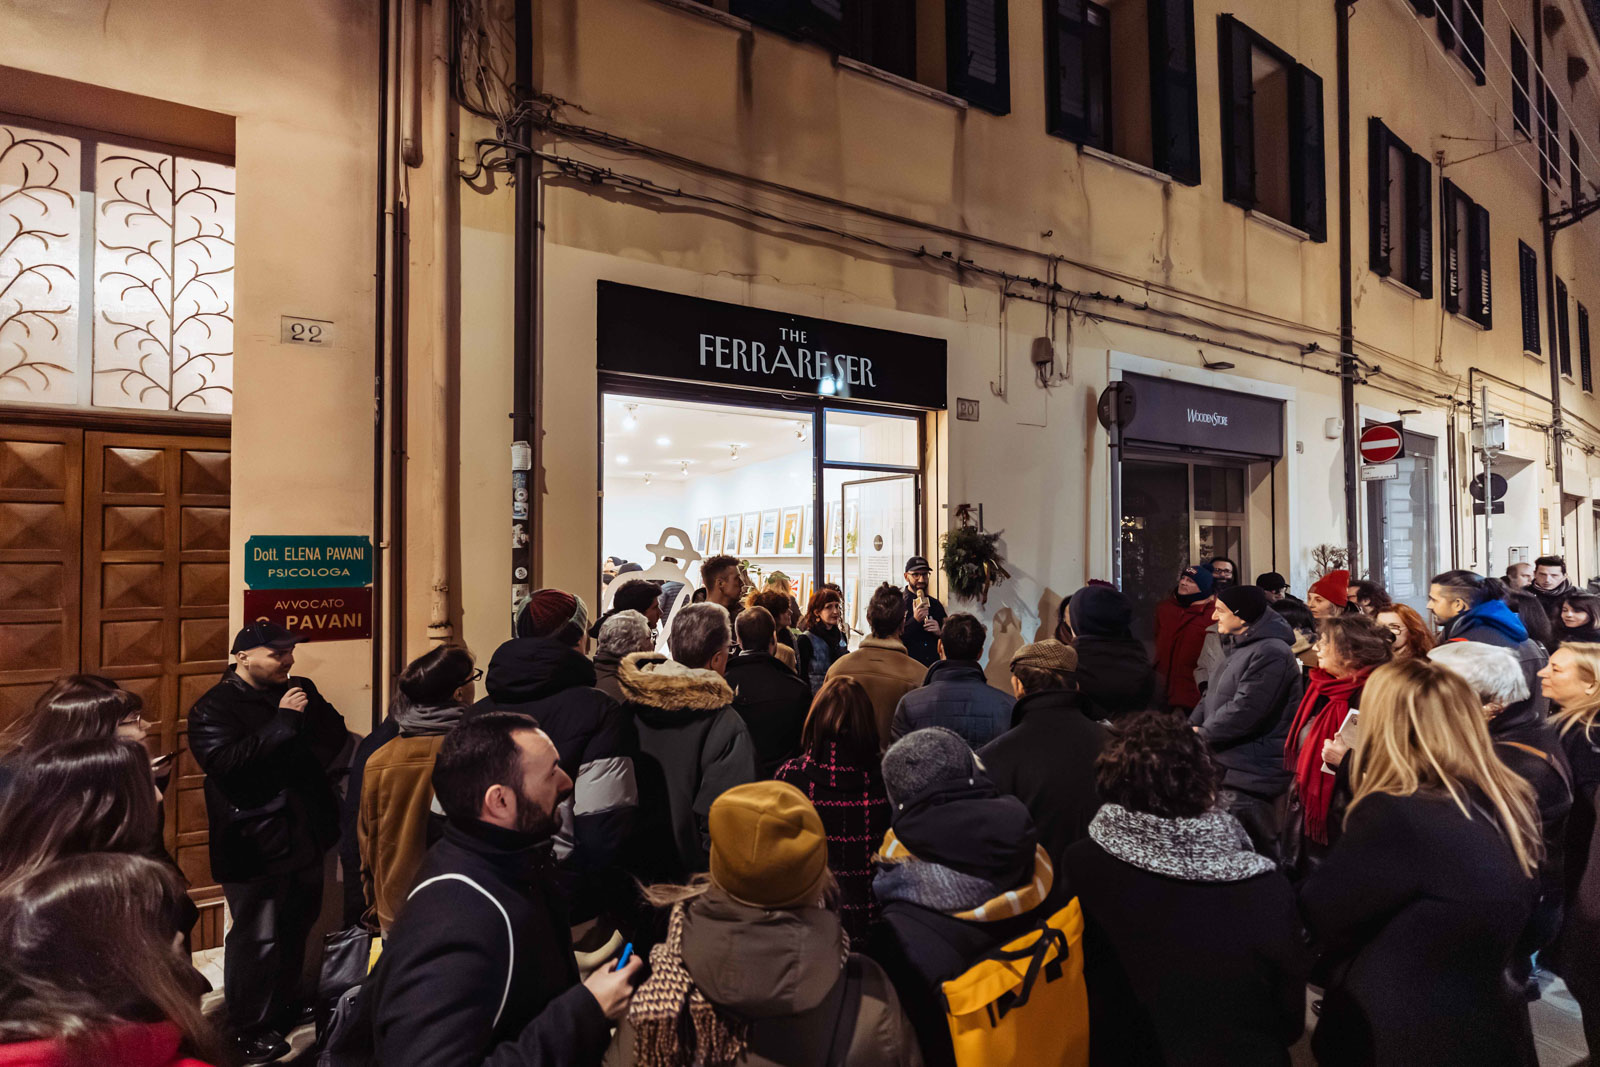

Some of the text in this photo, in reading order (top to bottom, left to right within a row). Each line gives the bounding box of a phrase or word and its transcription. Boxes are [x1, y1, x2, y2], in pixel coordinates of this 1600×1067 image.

[291, 322, 322, 343] 22
[779, 327, 808, 344] THE
[253, 546, 365, 561] Dott. ELENA PAVANI
[267, 567, 351, 578] PSICOLOGA
[273, 598, 345, 610] AVVOCATO
[285, 612, 362, 631] PAVANI
